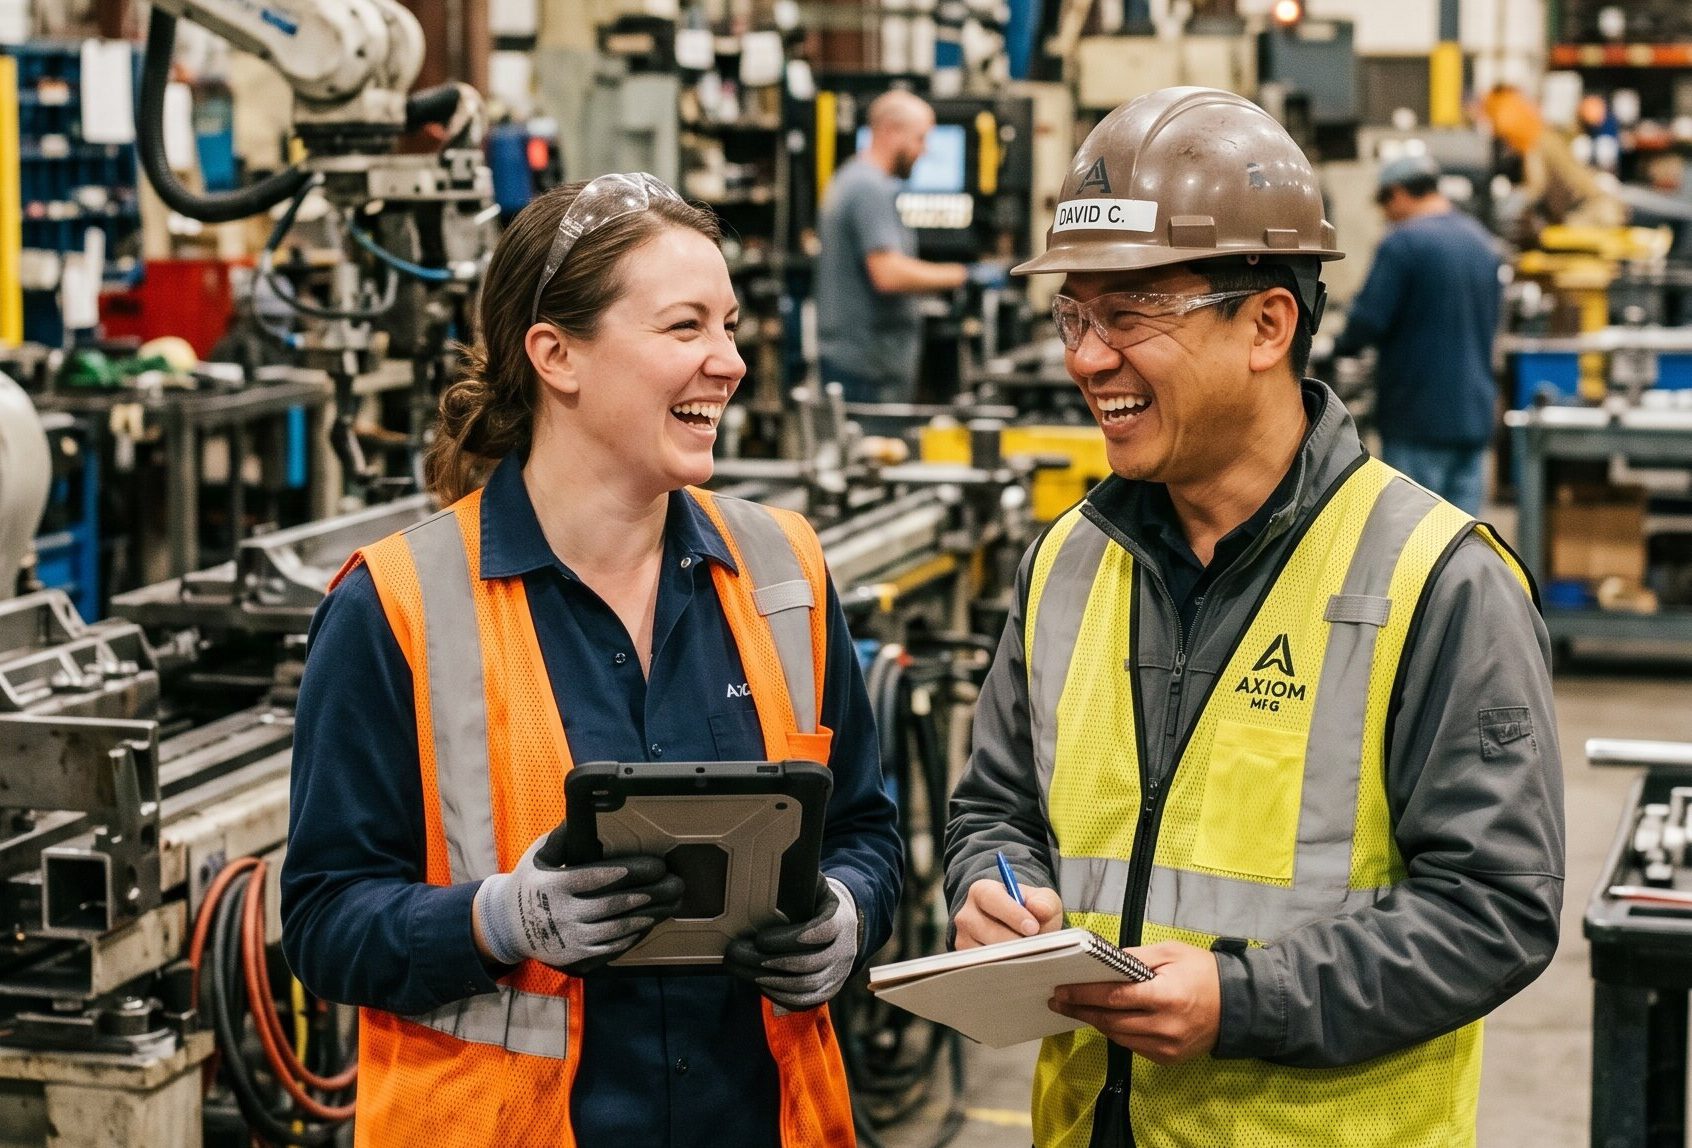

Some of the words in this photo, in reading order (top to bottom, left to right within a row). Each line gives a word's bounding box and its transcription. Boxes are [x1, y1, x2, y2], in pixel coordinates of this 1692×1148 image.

[1059, 205, 1101, 225] DAVID
[1107, 205, 1125, 223] C.
[1234, 676, 1306, 700] AXIOM
[1250, 697, 1280, 712] MFG
